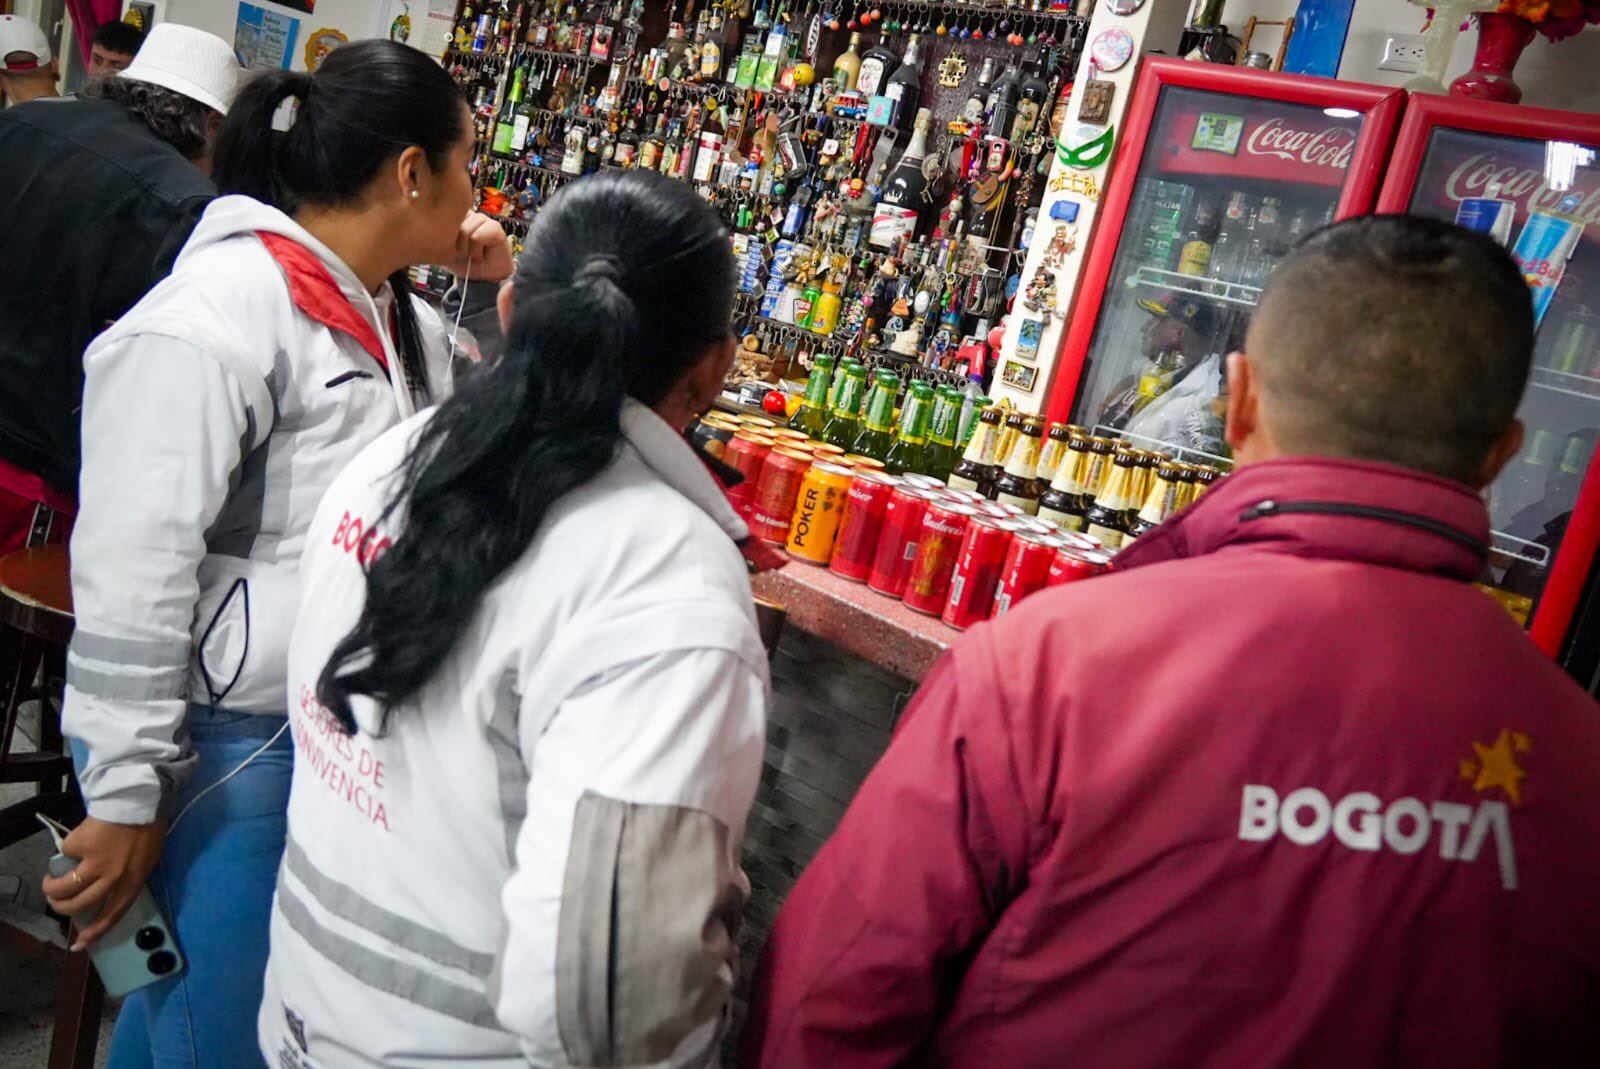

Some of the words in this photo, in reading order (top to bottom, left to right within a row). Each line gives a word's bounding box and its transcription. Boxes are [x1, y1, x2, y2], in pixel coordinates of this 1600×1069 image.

[794, 488, 820, 547] POKER
[294, 716, 390, 833] CONVIVENCIA
[359, 748, 385, 788] DE
